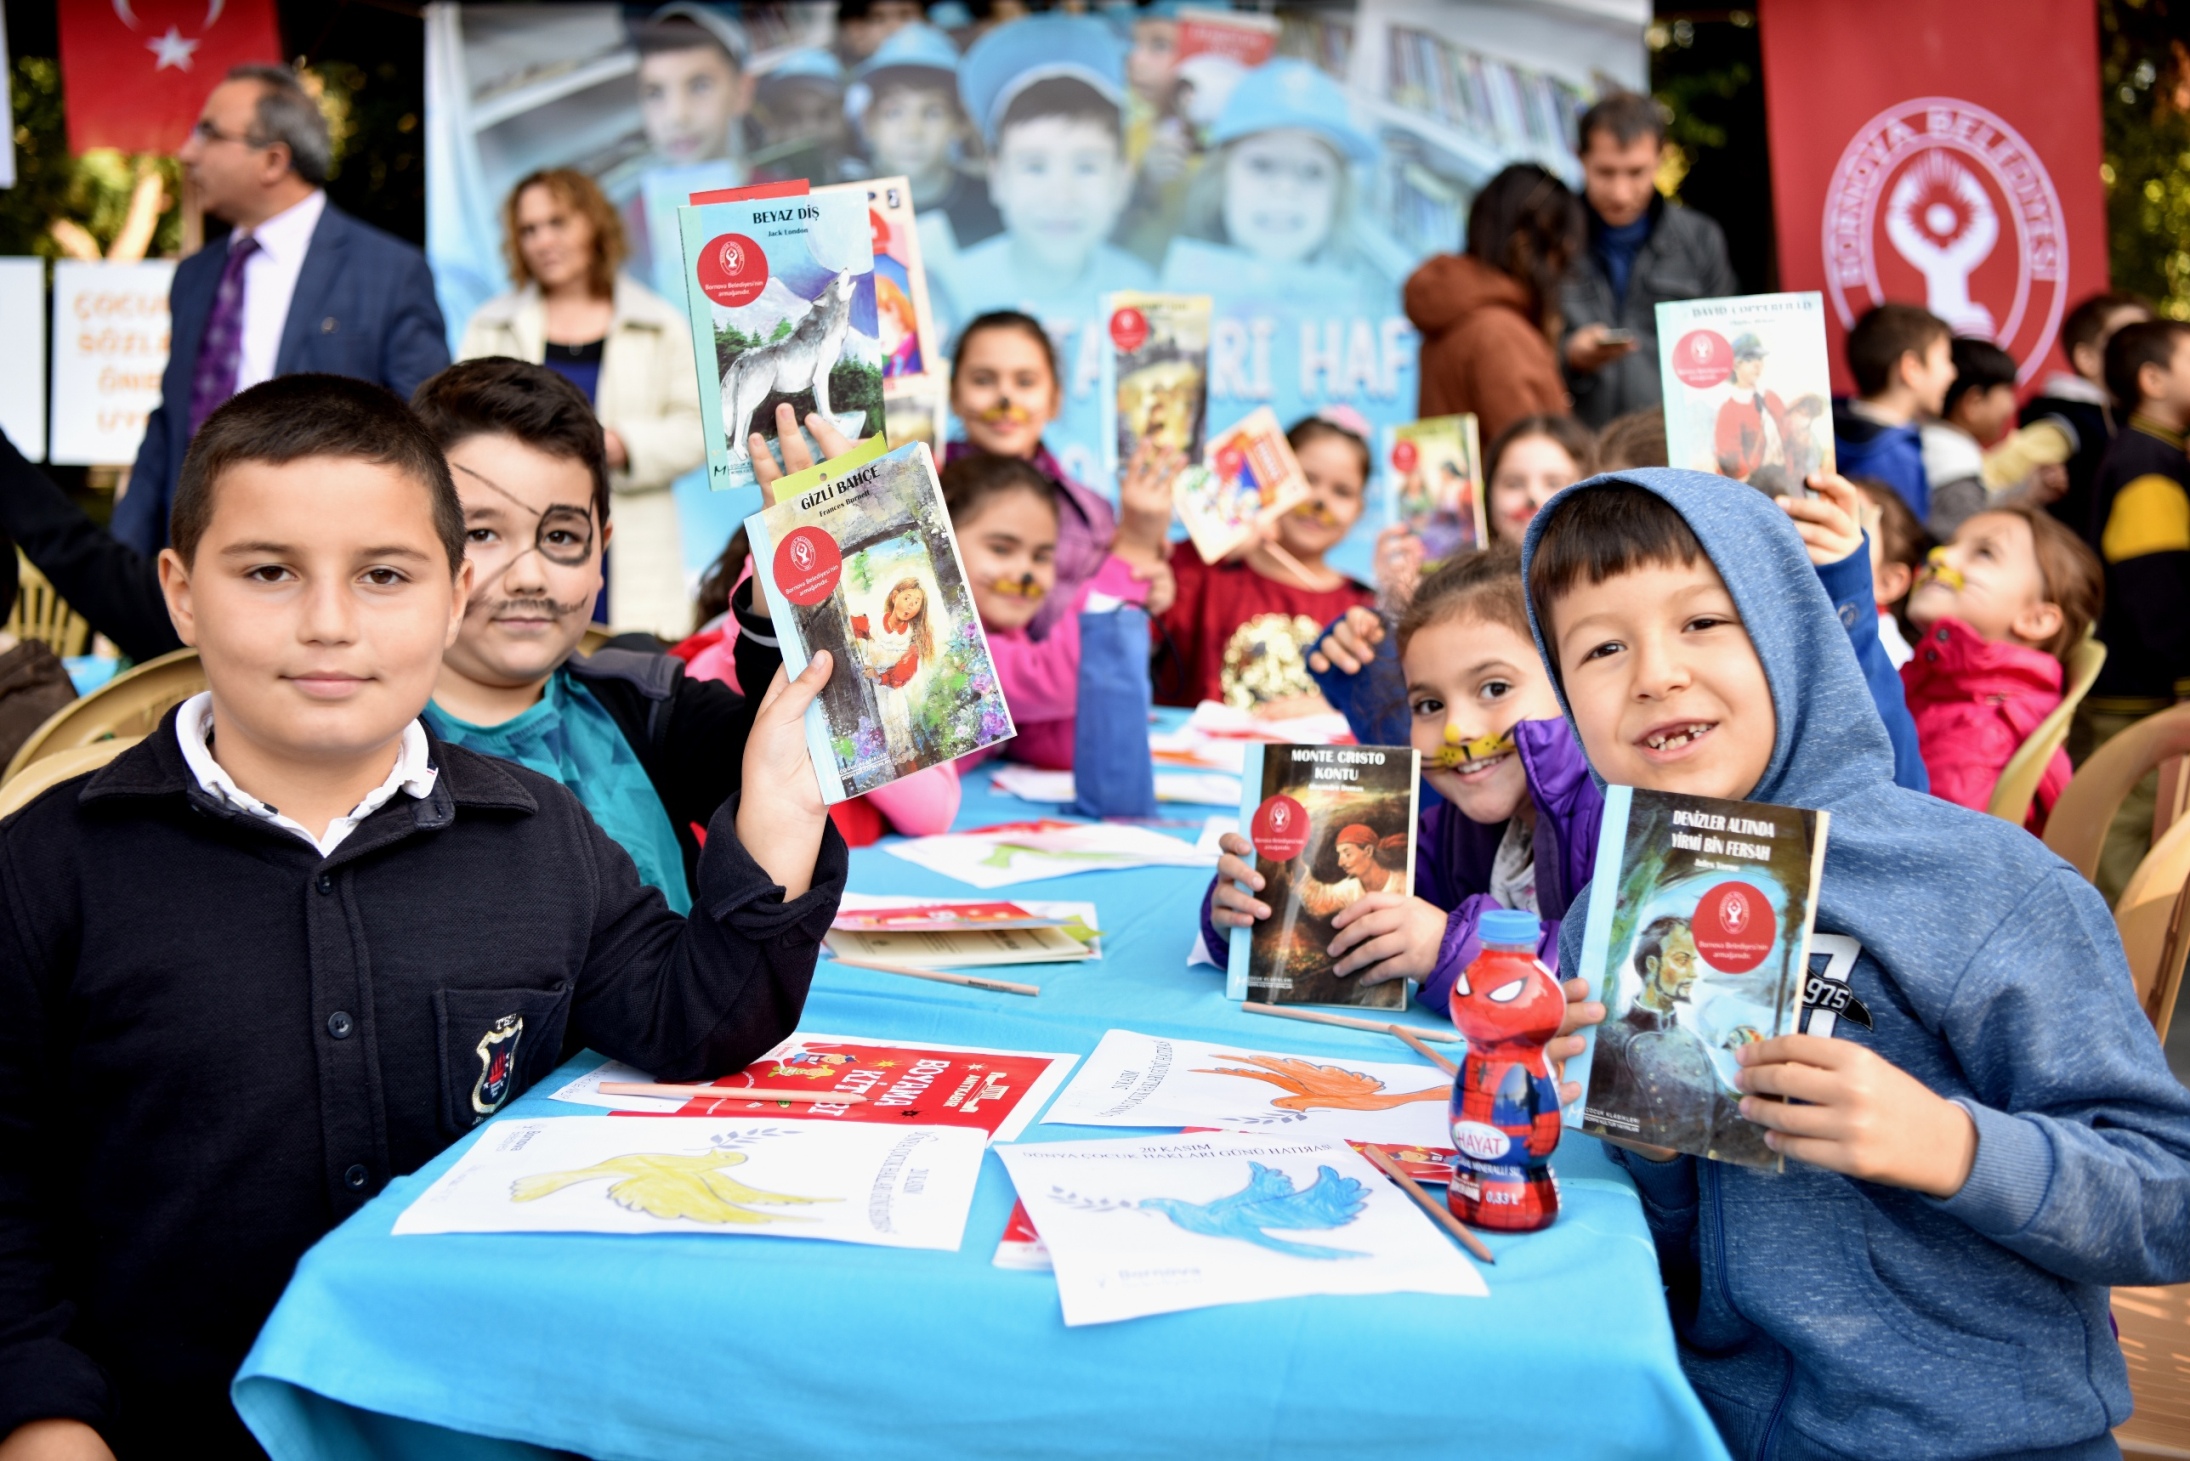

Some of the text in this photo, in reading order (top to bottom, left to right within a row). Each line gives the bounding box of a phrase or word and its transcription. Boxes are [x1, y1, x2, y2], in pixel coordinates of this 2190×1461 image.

[753, 204, 820, 224] BEYAZ DİŞ
[768, 227, 809, 237] Jack London
[801, 465, 880, 510] GİZLİ BAHÇE
[819, 502, 845, 517] Frances
[785, 582, 806, 595] Bornova
[1291, 749, 1386, 765] MONTE CRISTO
[1314, 767, 1359, 781] KONTU
[1673, 810, 1775, 838] DENİZLER ALTINDA
[1672, 831, 1771, 861] YİRMİ BİN FERSAH
[807, 1069, 888, 1117] KİTBI
[873, 1059, 951, 1107] BOYAMA
[943, 1074, 981, 1108] ANITKABİR
[1160, 1143, 1211, 1152] KASIM
[1456, 1130, 1503, 1155] HAYAT
